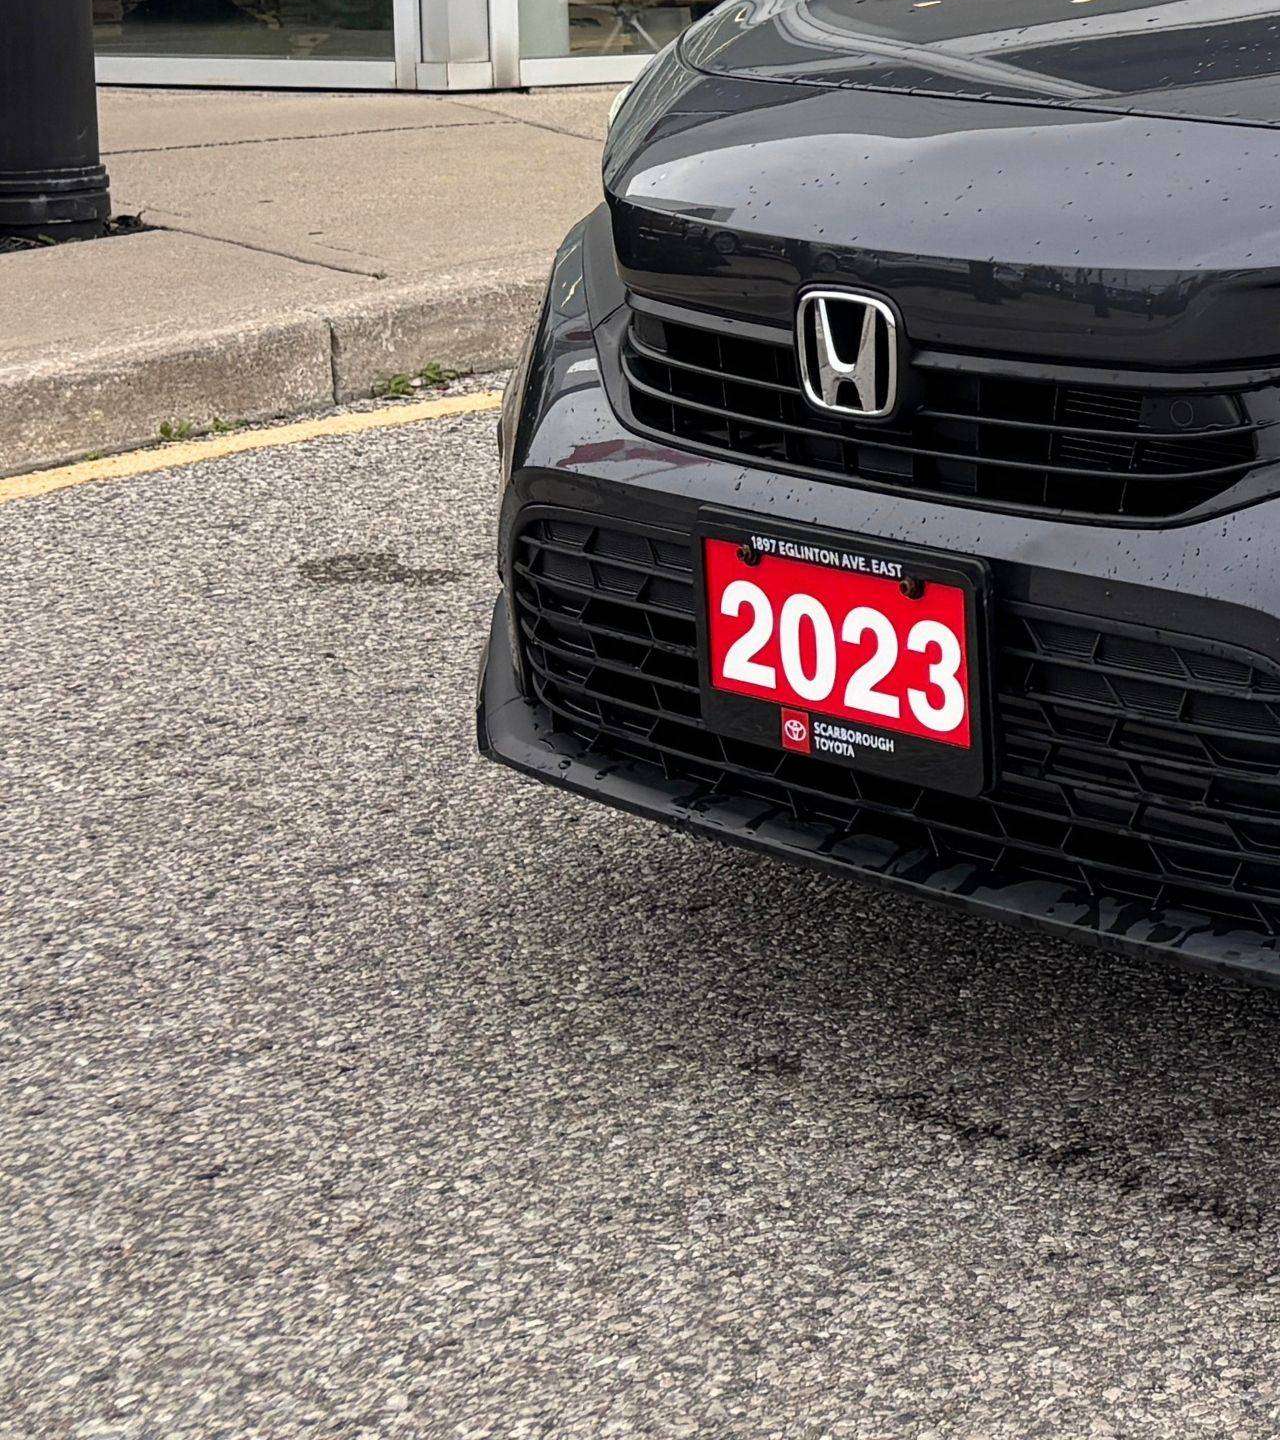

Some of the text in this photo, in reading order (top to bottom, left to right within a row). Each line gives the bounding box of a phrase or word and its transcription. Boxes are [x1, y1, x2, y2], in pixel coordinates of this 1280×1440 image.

[751, 536, 902, 578] 1897 EGLINTON AVE. EAST
[720, 580, 965, 732] 2023
[813, 721, 894, 753] SCARBOROUGH
[814, 736, 855, 758] TOYOTA
